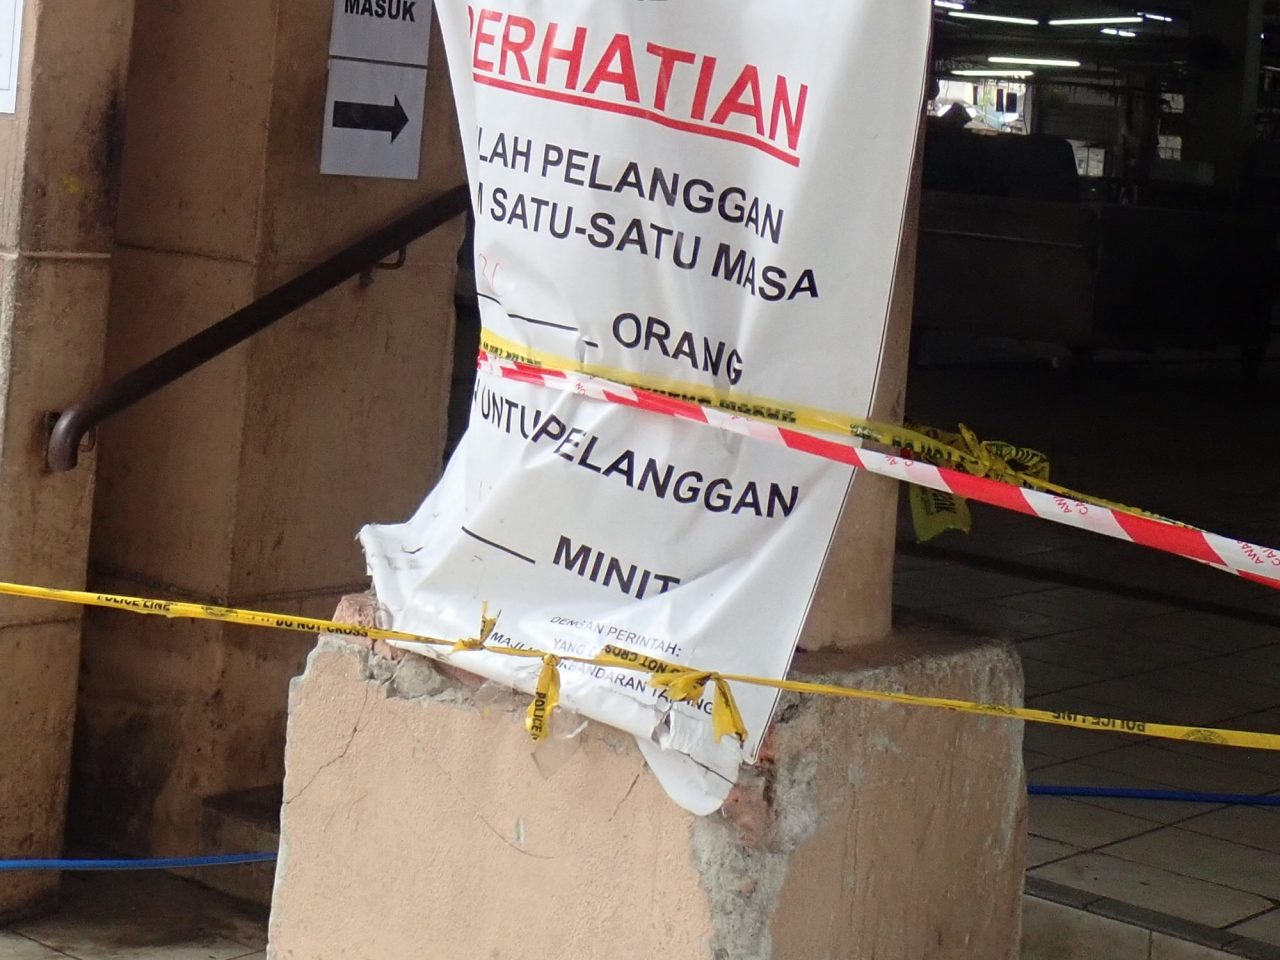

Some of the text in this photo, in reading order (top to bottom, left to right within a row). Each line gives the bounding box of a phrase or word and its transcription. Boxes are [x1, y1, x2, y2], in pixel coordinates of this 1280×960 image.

[467, 5, 809, 152] ERHATIAN
[477, 126, 533, 174] LAH
[541, 143, 785, 244] PELANGGAN
[490, 186, 702, 270] SATU-SATU
[711, 242, 820, 302] MASA
[612, 312, 743, 386] ORANG
[481, 384, 540, 440] UNTU
[531, 413, 800, 520] PELANGGAN
[552, 534, 681, 600] MINIT
[602, 644, 638, 663] CROS
[607, 625, 683, 658] PERINTAH:
[531, 691, 547, 733] POLICE
